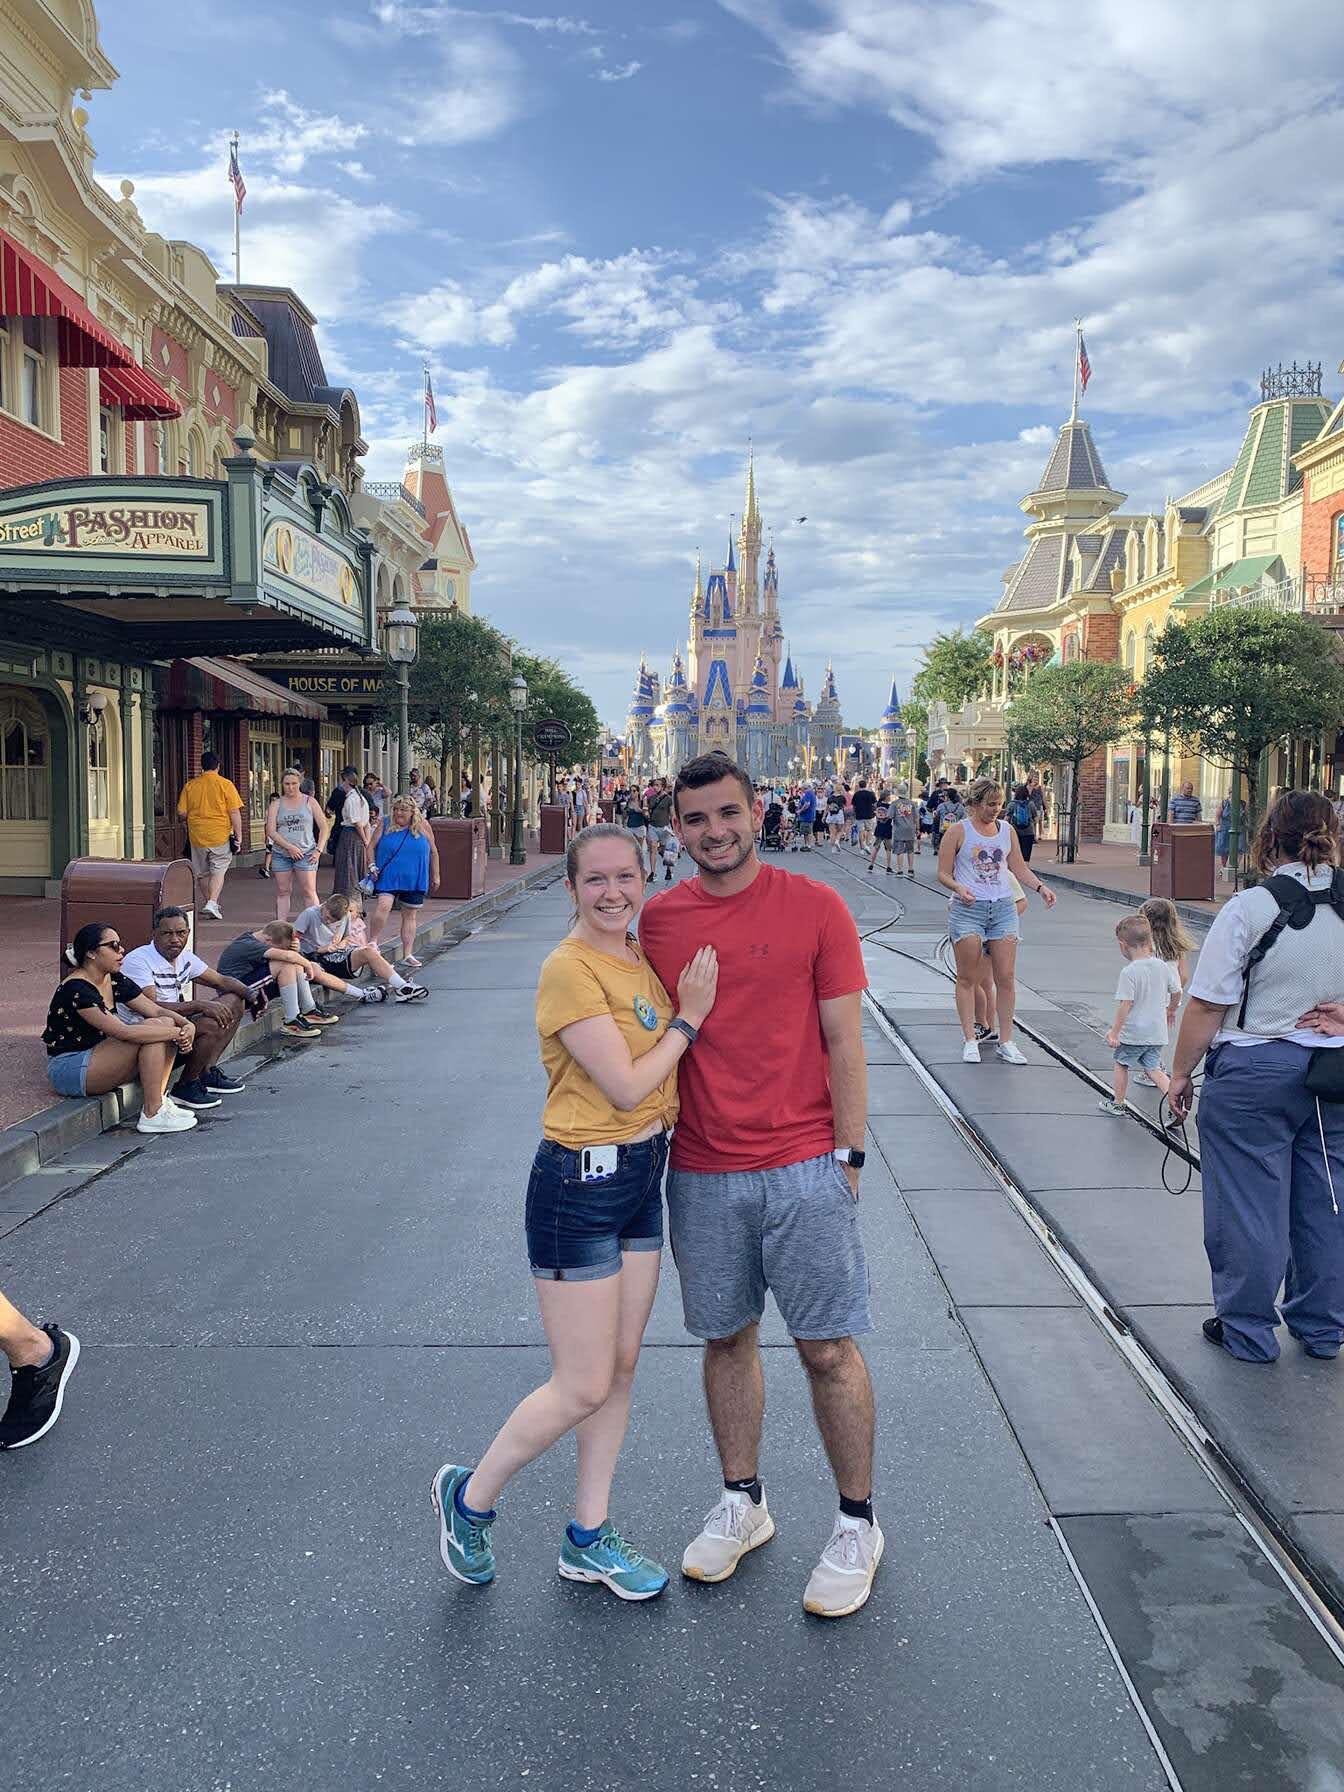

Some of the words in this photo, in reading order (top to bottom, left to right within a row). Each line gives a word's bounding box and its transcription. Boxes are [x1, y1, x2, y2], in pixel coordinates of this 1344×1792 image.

[61, 508, 198, 548] FASHION
[126, 532, 204, 550] APPAREL
[288, 677, 337, 692] HOUSE
[341, 678, 359, 692] OF
